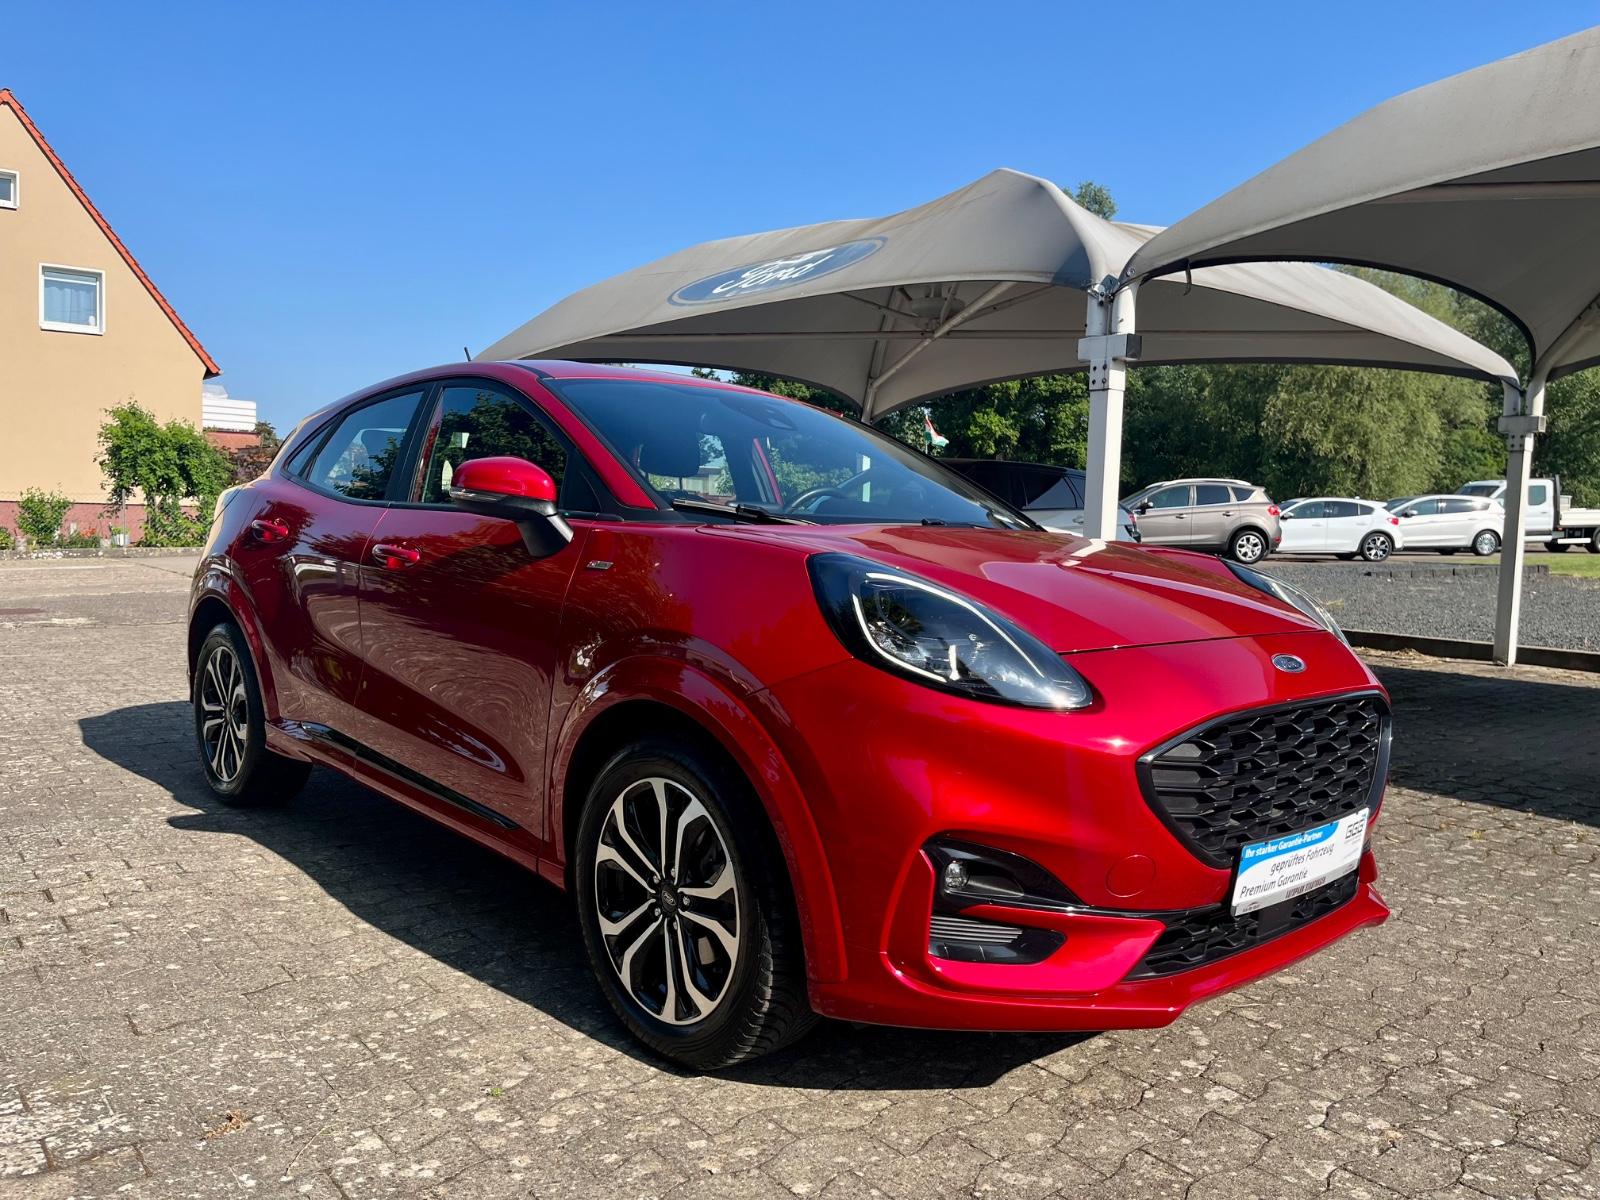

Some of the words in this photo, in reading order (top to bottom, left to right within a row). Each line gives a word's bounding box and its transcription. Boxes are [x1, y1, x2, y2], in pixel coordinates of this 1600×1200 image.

[712, 248, 837, 293] Ford
[1245, 848, 1255, 858] Ihr
[1256, 843, 1278, 856] starker
[1279, 831, 1323, 850] Garantie-Partner
[1270, 853, 1305, 876] geprüftes
[1306, 843, 1335, 861] Fahrzeug
[1240, 881, 1276, 897] Premium
[1277, 868, 1308, 887] Garantie
